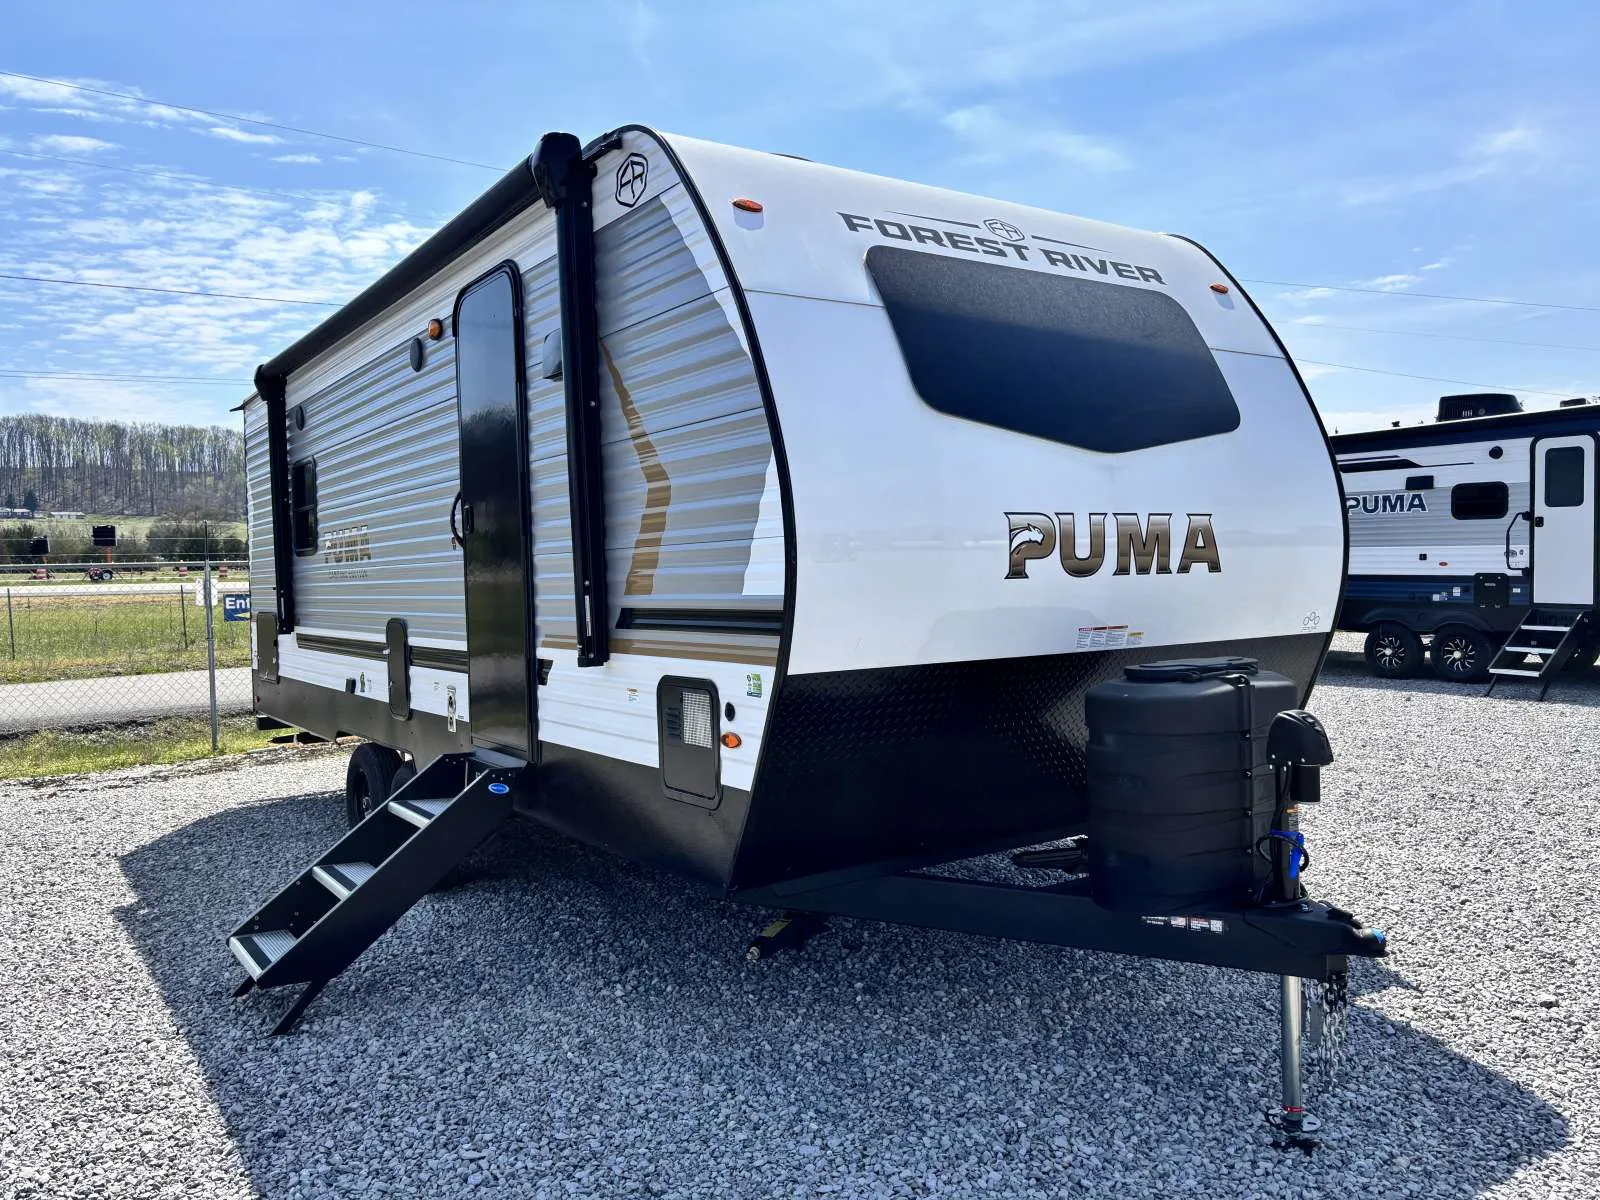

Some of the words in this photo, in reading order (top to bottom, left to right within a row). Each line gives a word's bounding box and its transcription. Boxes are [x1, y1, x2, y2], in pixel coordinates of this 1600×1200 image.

[836, 211, 1030, 261] FOREST
[1039, 248, 1167, 285] RIVER
[1344, 491, 1429, 515] PUMA
[1003, 511, 1222, 580] PUMA
